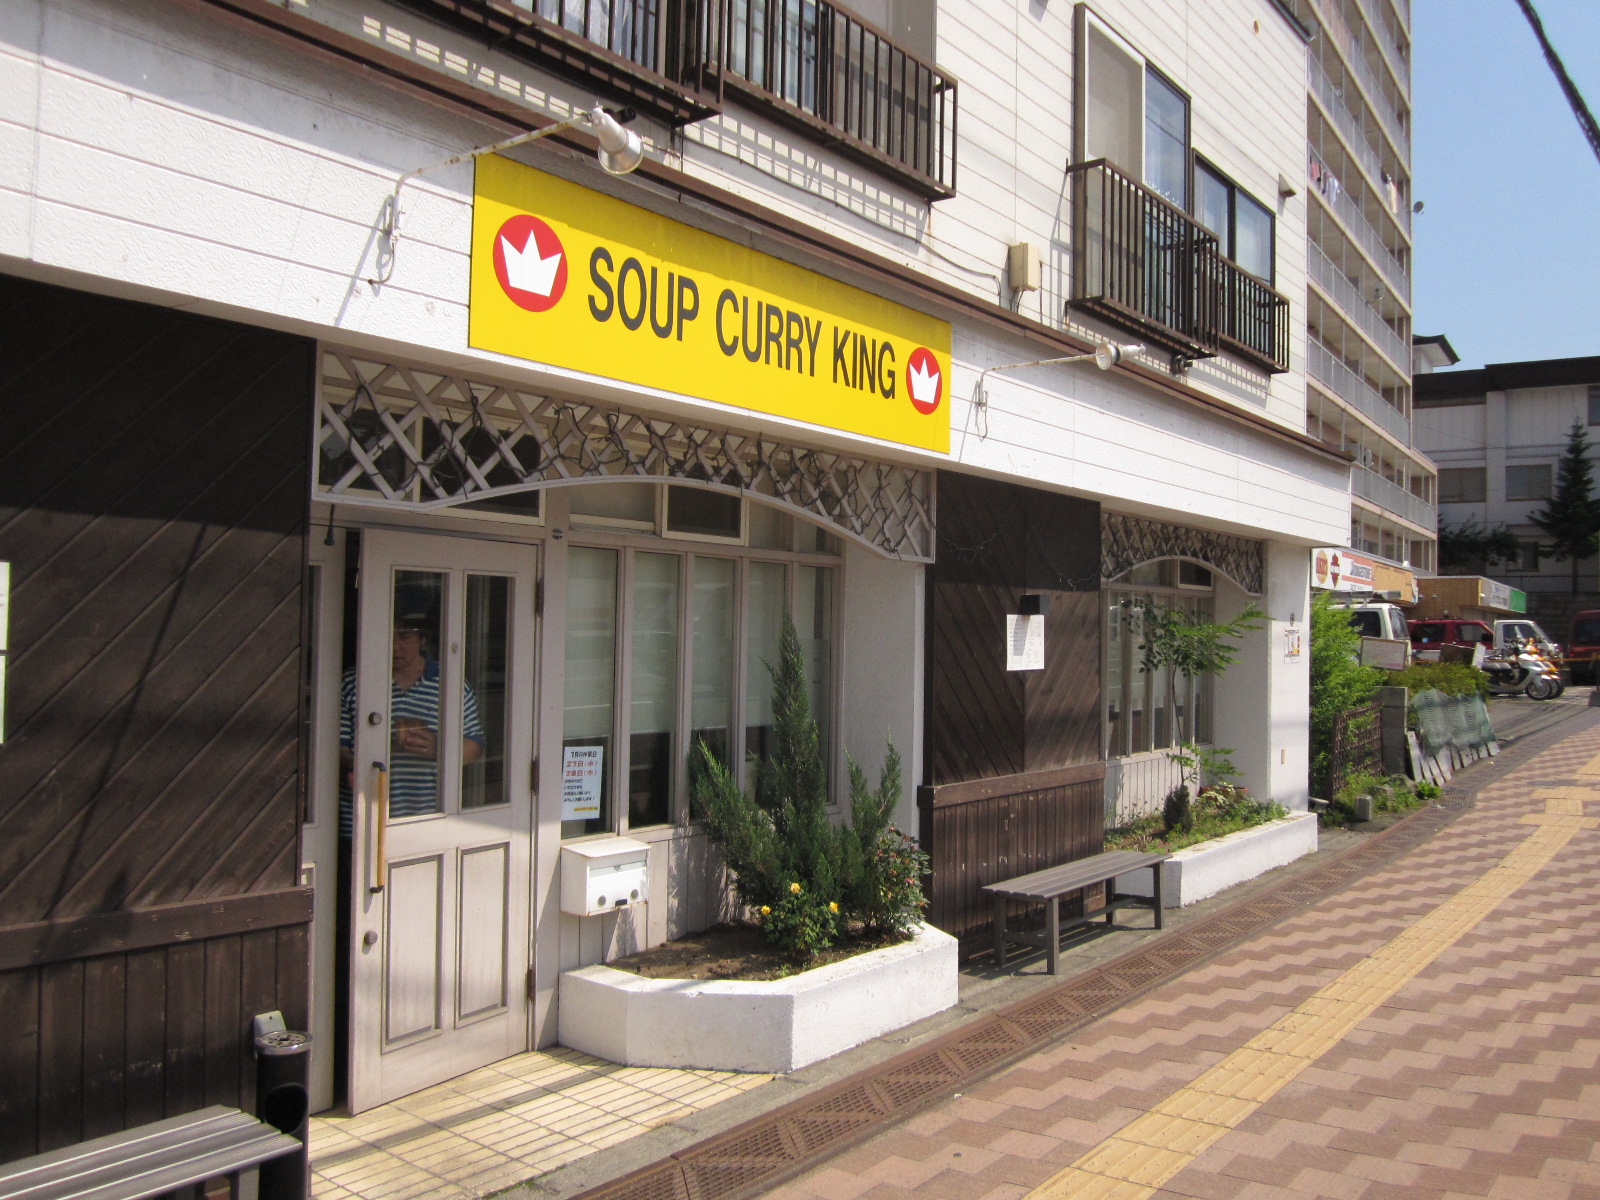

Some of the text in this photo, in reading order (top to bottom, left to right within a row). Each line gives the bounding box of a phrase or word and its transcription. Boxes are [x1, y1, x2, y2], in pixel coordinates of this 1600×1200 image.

[587, 246, 896, 400] SOUP CURRY KING
